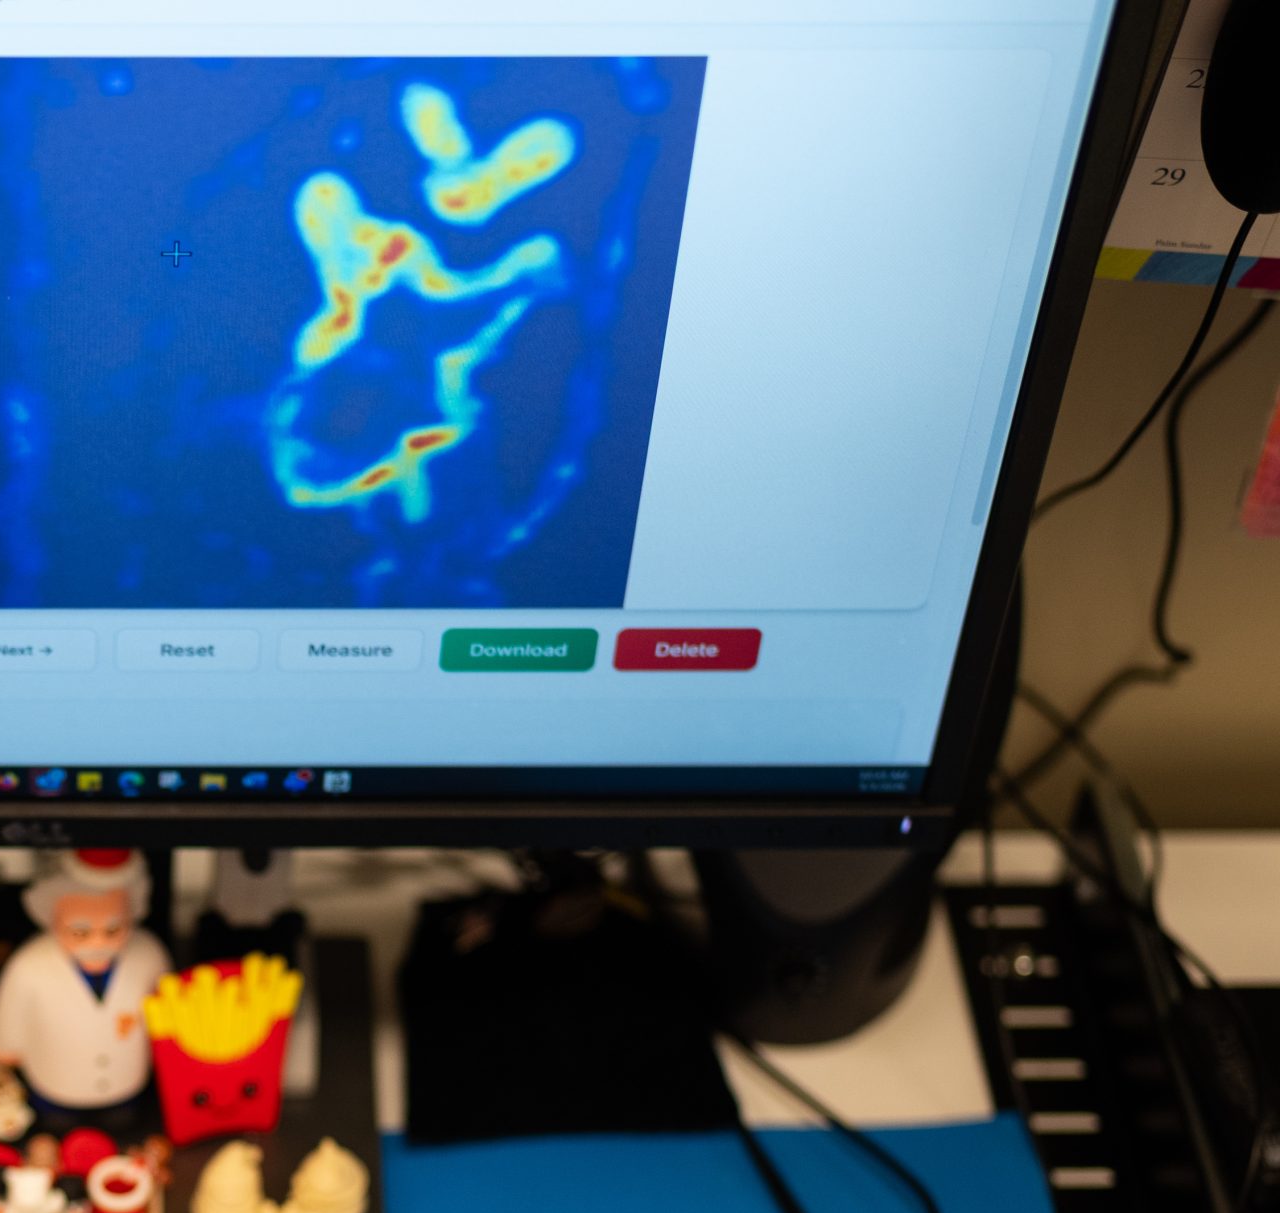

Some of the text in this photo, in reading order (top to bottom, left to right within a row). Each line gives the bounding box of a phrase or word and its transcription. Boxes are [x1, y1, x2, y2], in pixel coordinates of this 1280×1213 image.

[1185, 68, 1206, 89] 2
[1150, 167, 1187, 187] 29
[160, 643, 215, 657] Reset
[307, 643, 393, 657] Measure
[469, 642, 568, 658] Download
[654, 641, 719, 658] Delete
